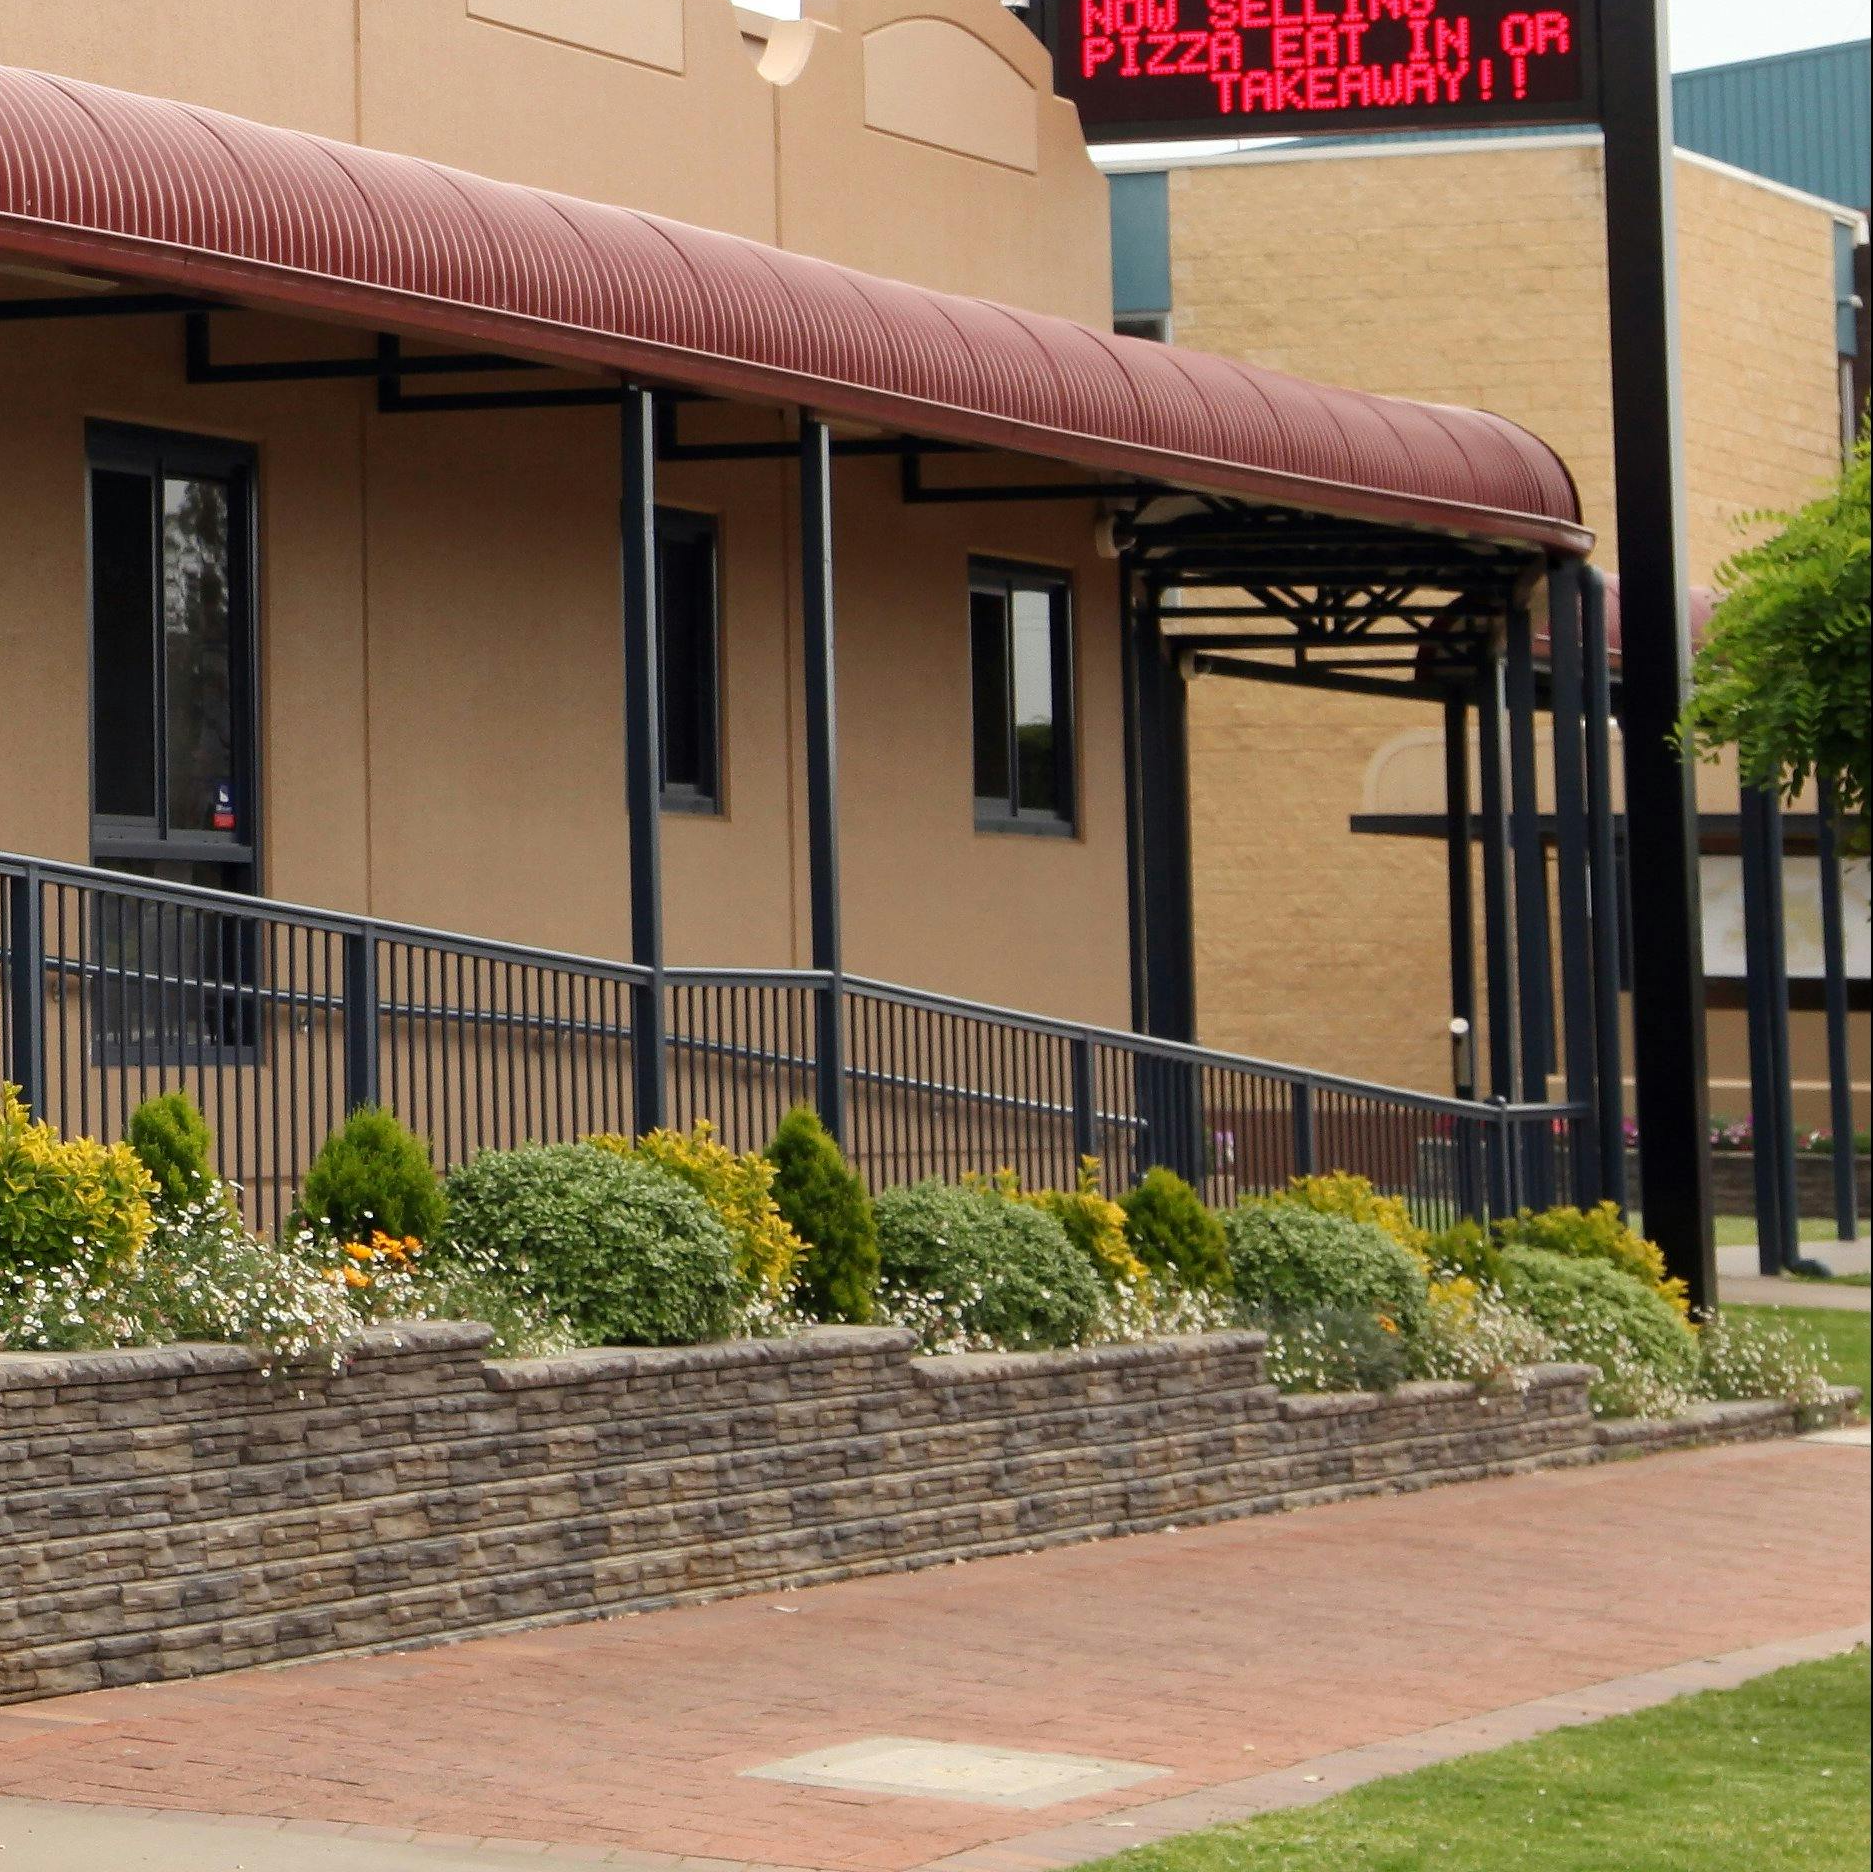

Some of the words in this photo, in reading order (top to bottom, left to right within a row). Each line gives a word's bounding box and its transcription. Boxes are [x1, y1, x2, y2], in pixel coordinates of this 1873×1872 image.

[1081, 30, 1243, 78] PIZZA
[1272, 23, 1369, 69] EAT
[1408, 16, 1470, 63] IN
[1501, 11, 1570, 56] OR
[1211, 56, 1528, 114] TAKEAWAY!!
